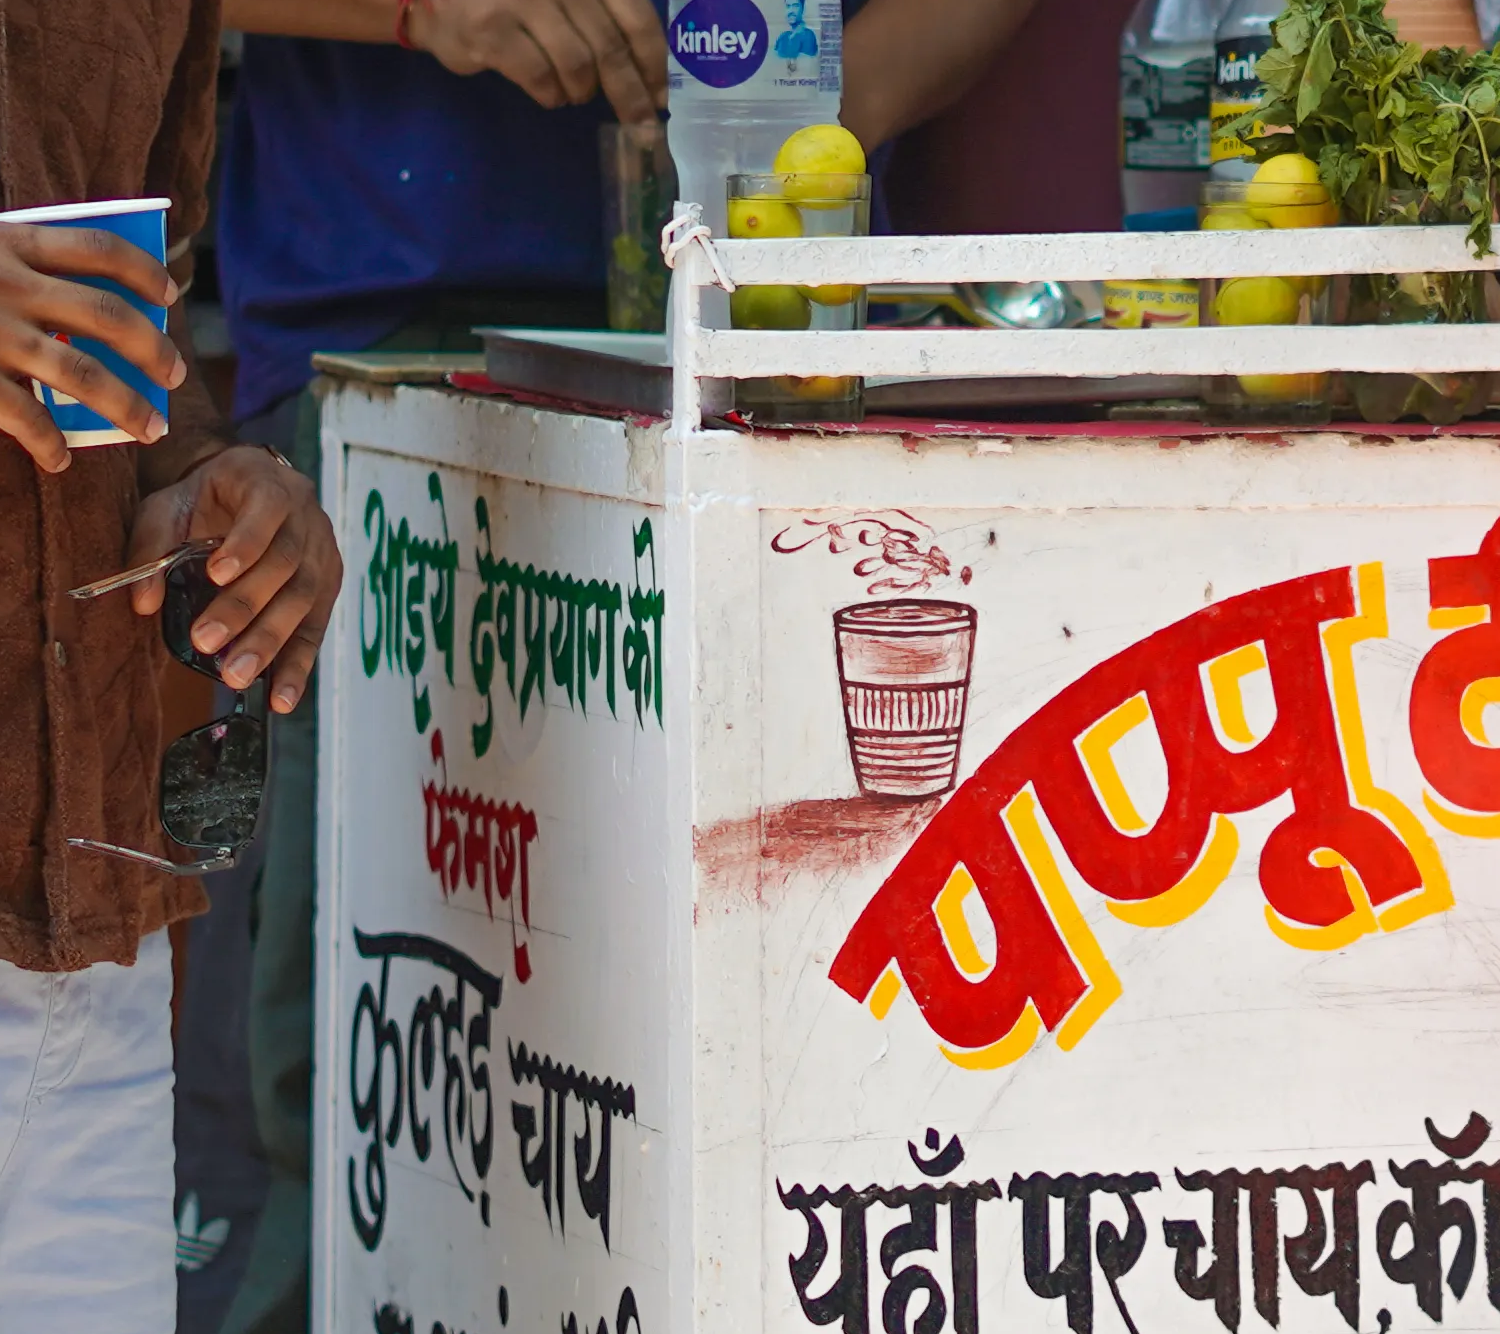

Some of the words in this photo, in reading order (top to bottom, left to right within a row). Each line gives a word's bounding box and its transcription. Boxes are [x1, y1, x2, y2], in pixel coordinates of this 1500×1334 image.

[677, 21, 758, 59] kinley
[1217, 52, 1258, 85] kinl
[470, 495, 622, 761] देवप्रयाग
[622, 517, 665, 733] की
[829, 561, 1454, 1069] पप्पू
[349, 924, 504, 1254] कुल्हड़
[508, 1035, 638, 1259] चाय
